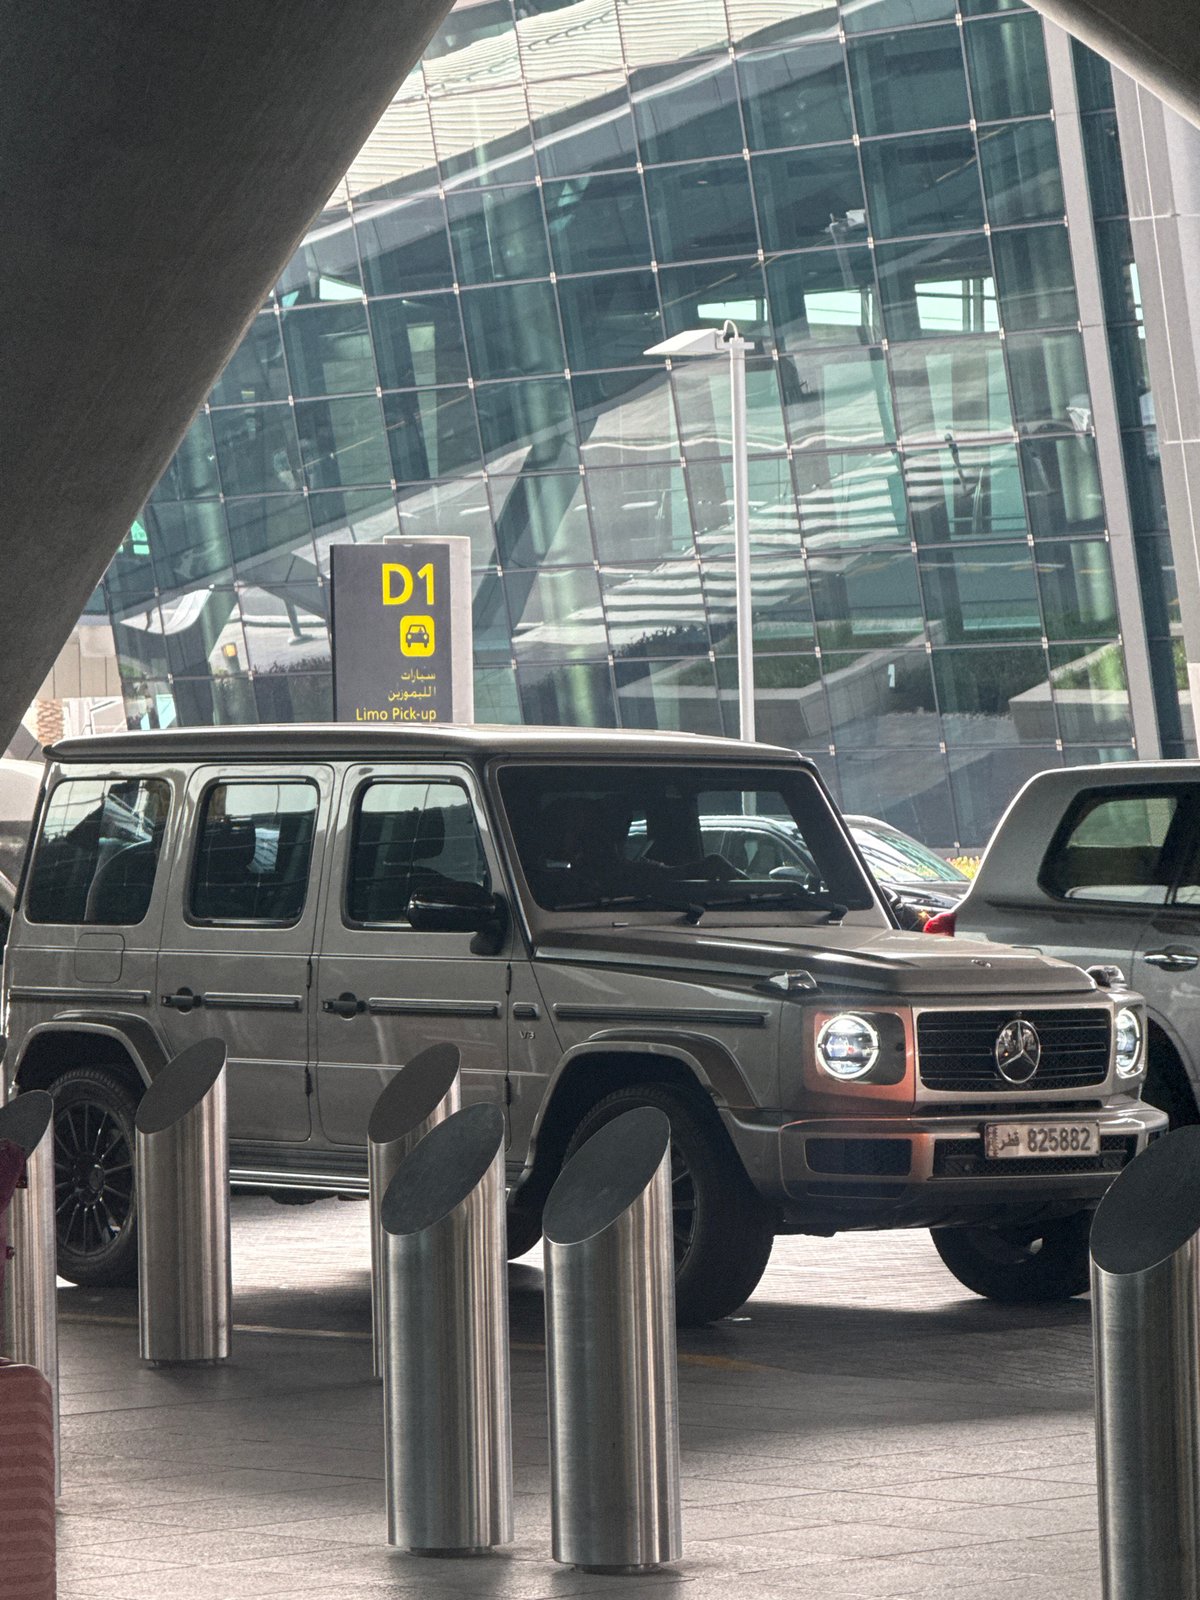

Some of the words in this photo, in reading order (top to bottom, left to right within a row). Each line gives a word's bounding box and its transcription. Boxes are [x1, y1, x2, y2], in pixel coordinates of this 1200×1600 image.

[382, 562, 435, 606] D1
[401, 668, 436, 683] سيارات
[388, 685, 436, 702] الليموزين
[356, 707, 388, 721] Limo
[392, 706, 437, 723] Pick-up
[999, 1130, 1020, 1151] قطر
[1027, 1127, 1091, 1152] 825882
